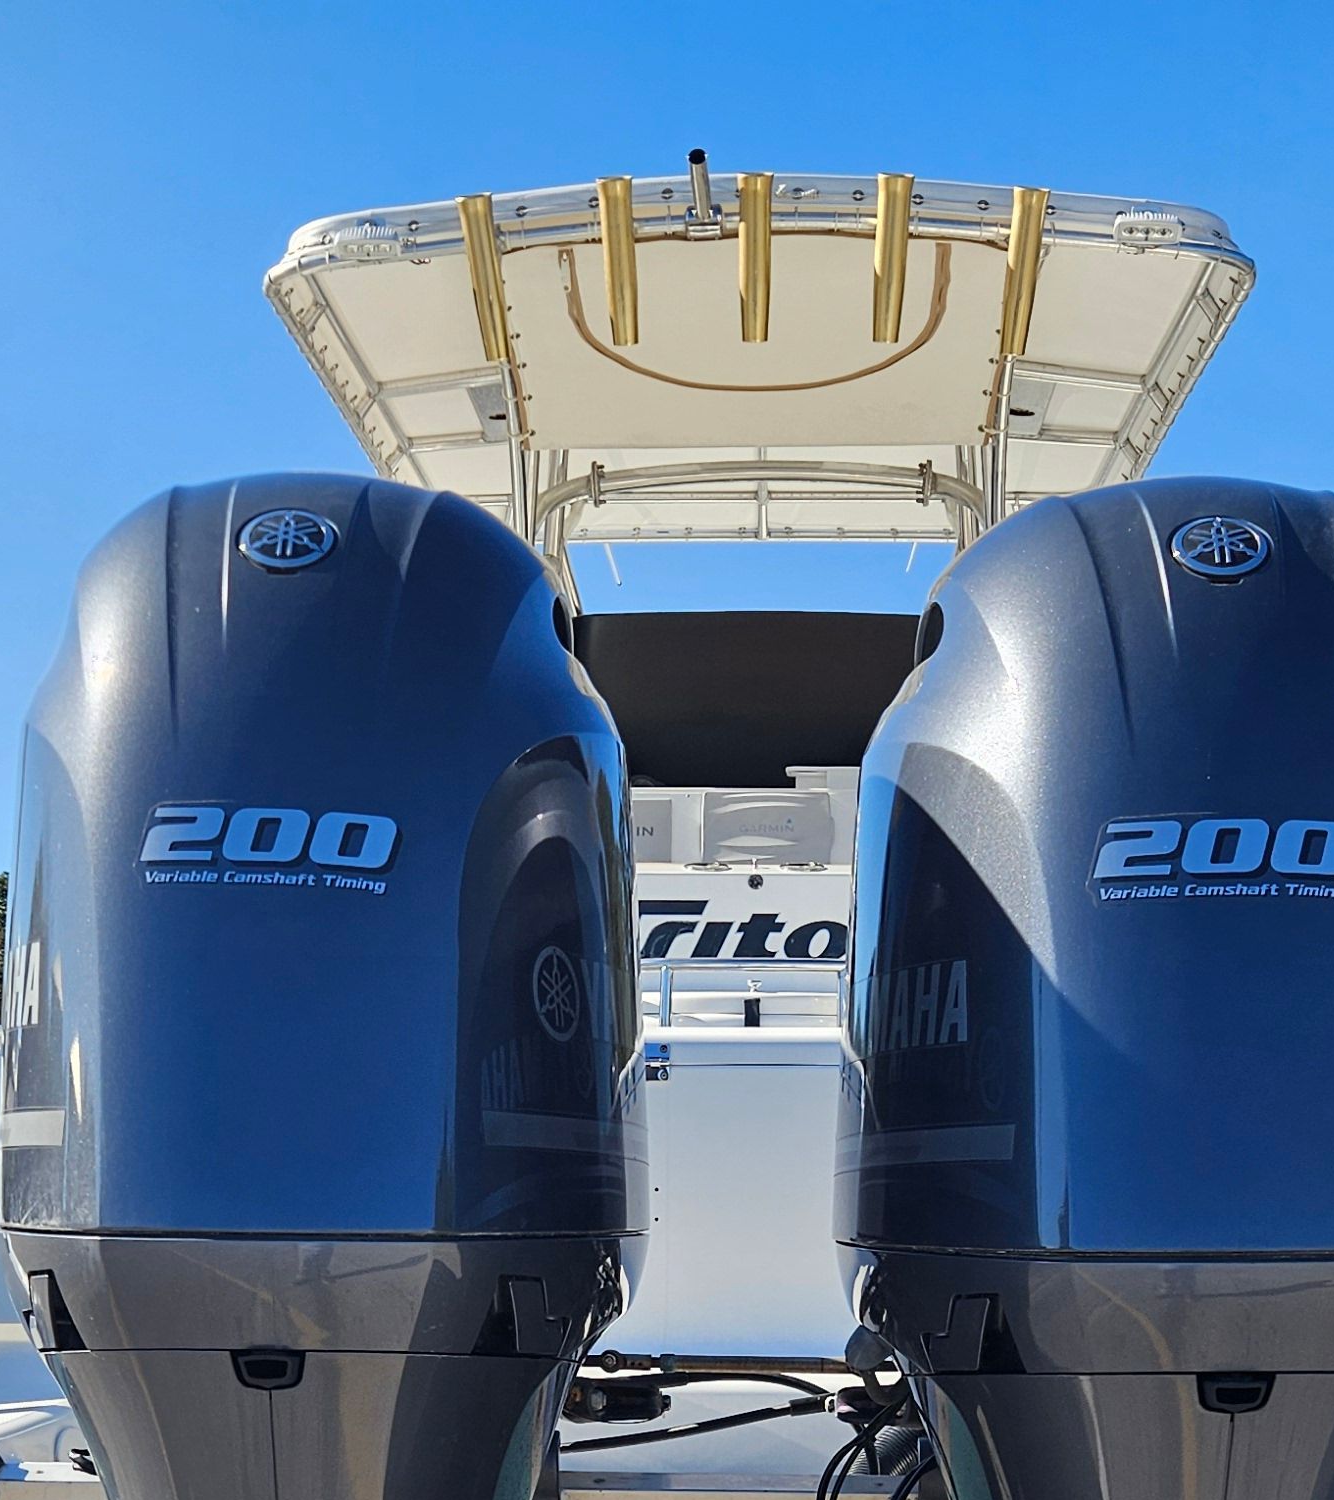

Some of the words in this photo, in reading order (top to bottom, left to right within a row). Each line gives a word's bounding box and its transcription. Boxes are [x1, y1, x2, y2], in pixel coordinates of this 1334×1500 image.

[139, 807, 398, 869] 200
[738, 823, 795, 834] GARMIN
[145, 870, 218, 884] Variable
[223, 870, 316, 886] Camshaft
[322, 873, 387, 895] Timing
[1099, 883, 1179, 900] Variable
[1184, 882, 1279, 897] Camshaft
